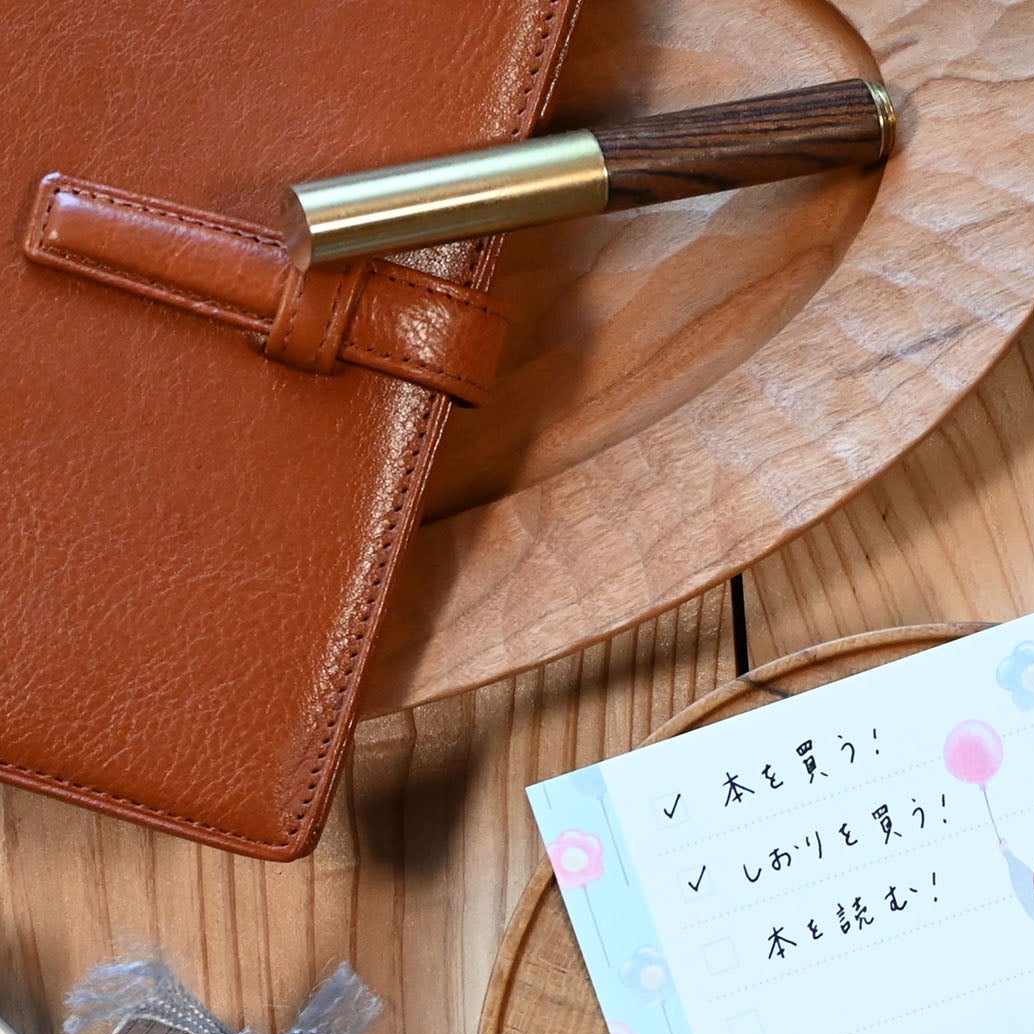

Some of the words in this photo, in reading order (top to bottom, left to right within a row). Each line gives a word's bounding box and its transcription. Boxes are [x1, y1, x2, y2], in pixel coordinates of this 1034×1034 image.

[722, 728, 881, 807] 本を買う!
[742, 793, 948, 883] しおりを買う!
[767, 871, 939, 960] 本を読む!
